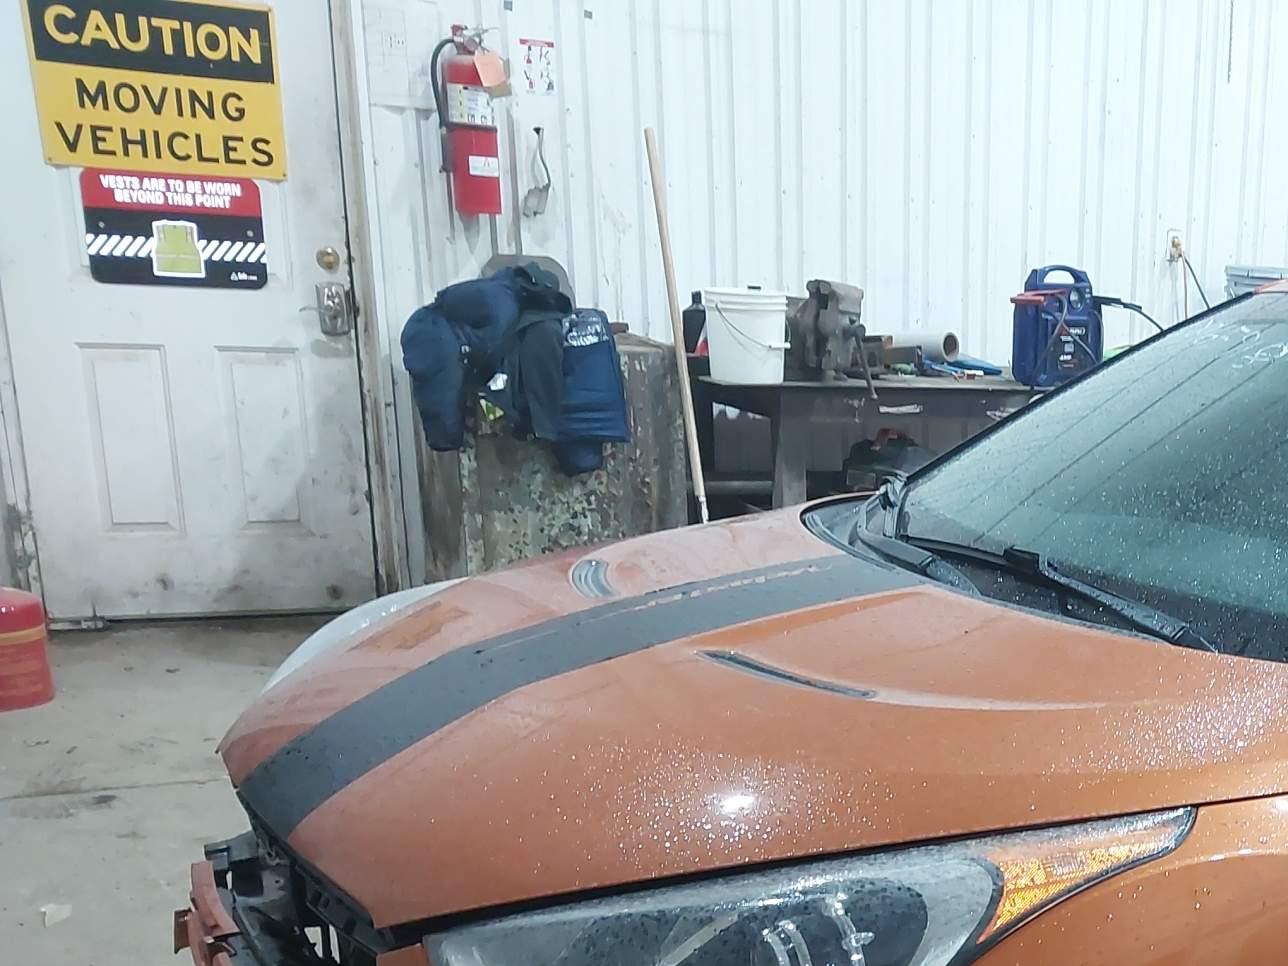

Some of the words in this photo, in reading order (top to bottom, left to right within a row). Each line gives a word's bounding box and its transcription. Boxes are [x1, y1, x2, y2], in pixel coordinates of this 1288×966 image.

[43, 4, 262, 64] CAUTION
[75, 77, 246, 122] MOVING
[54, 121, 274, 166] VEHICLES
[99, 174, 140, 190] VESTS
[142, 177, 167, 191] ARE
[167, 179, 185, 194] TO
[187, 180, 203, 194] BE
[203, 182, 242, 198] WORN
[114, 189, 165, 205] BEYOND
[166, 192, 195, 207] THIS
[195, 194, 232, 209] POINT
